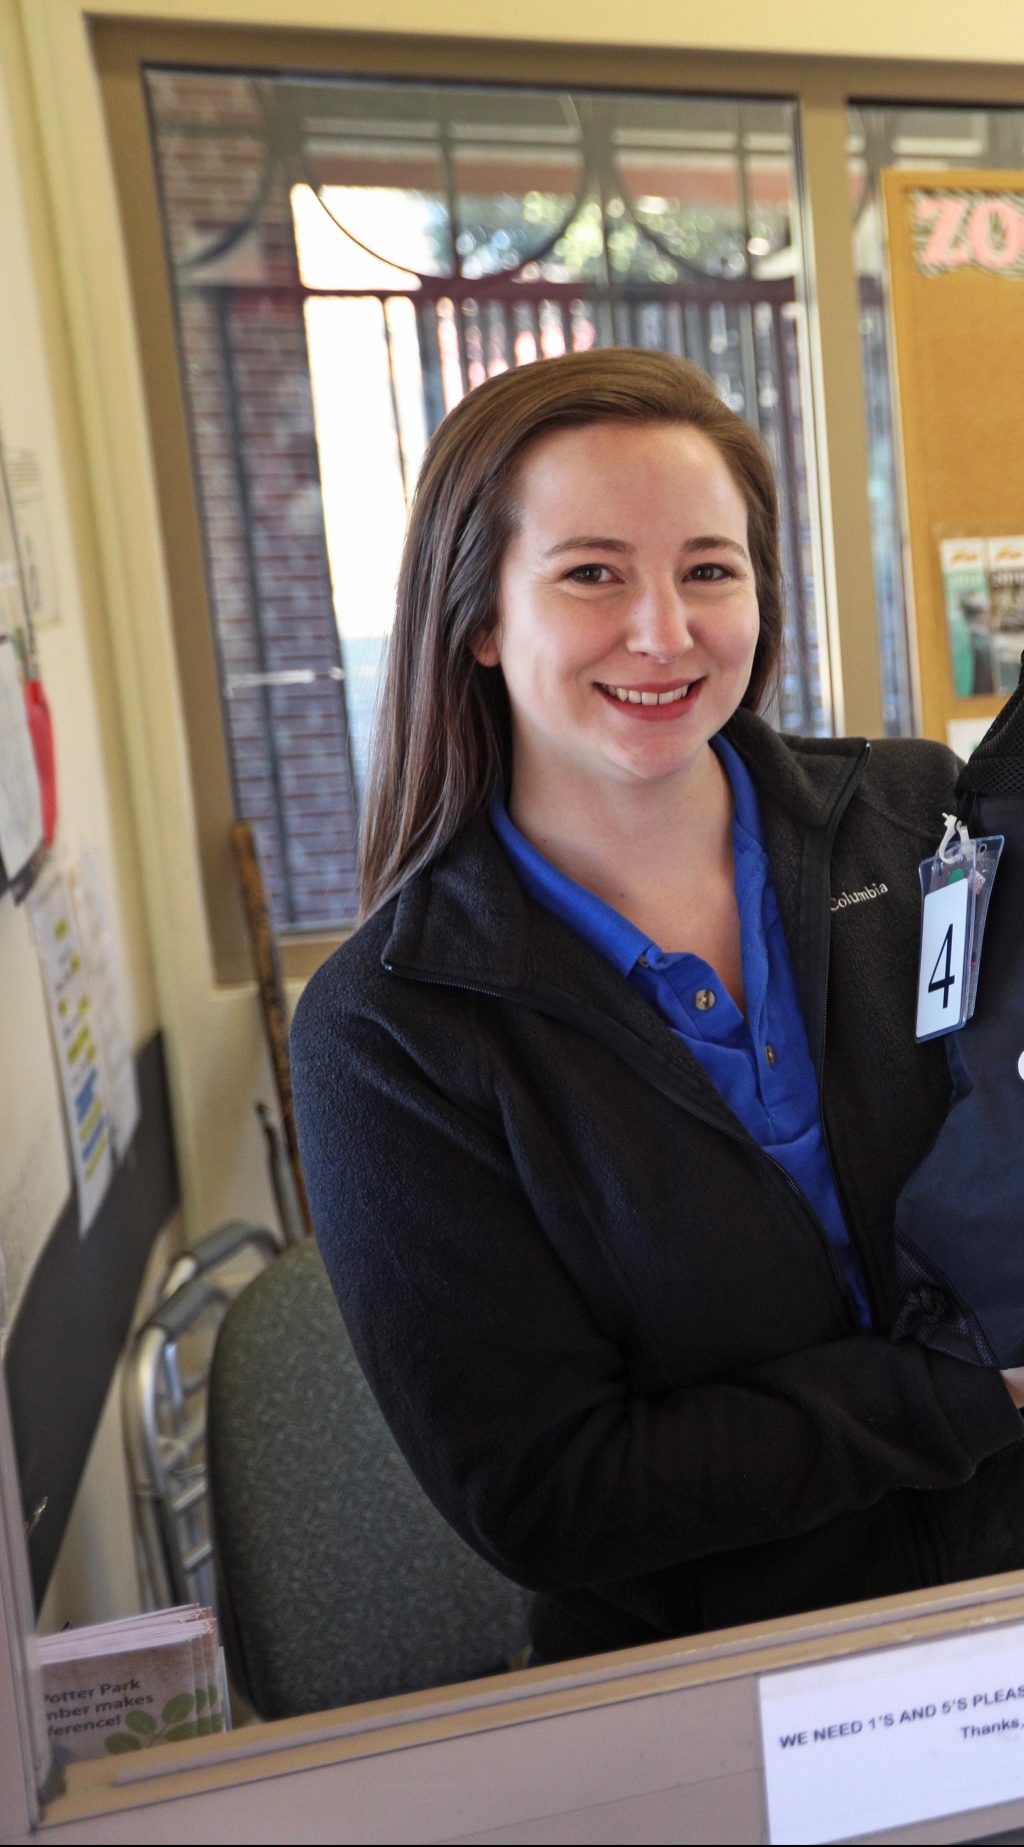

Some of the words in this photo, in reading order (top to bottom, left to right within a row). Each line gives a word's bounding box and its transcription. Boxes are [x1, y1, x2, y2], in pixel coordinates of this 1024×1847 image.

[927, 923, 955, 1009] 4
[100, 1679, 140, 1695] Park
[95, 1694, 154, 1713] makes
[779, 1733, 808, 1749] WE
[813, 1720, 863, 1742] NEED
[899, 1705, 937, 1724] AND
[960, 1718, 1024, 1740] Thanks,
